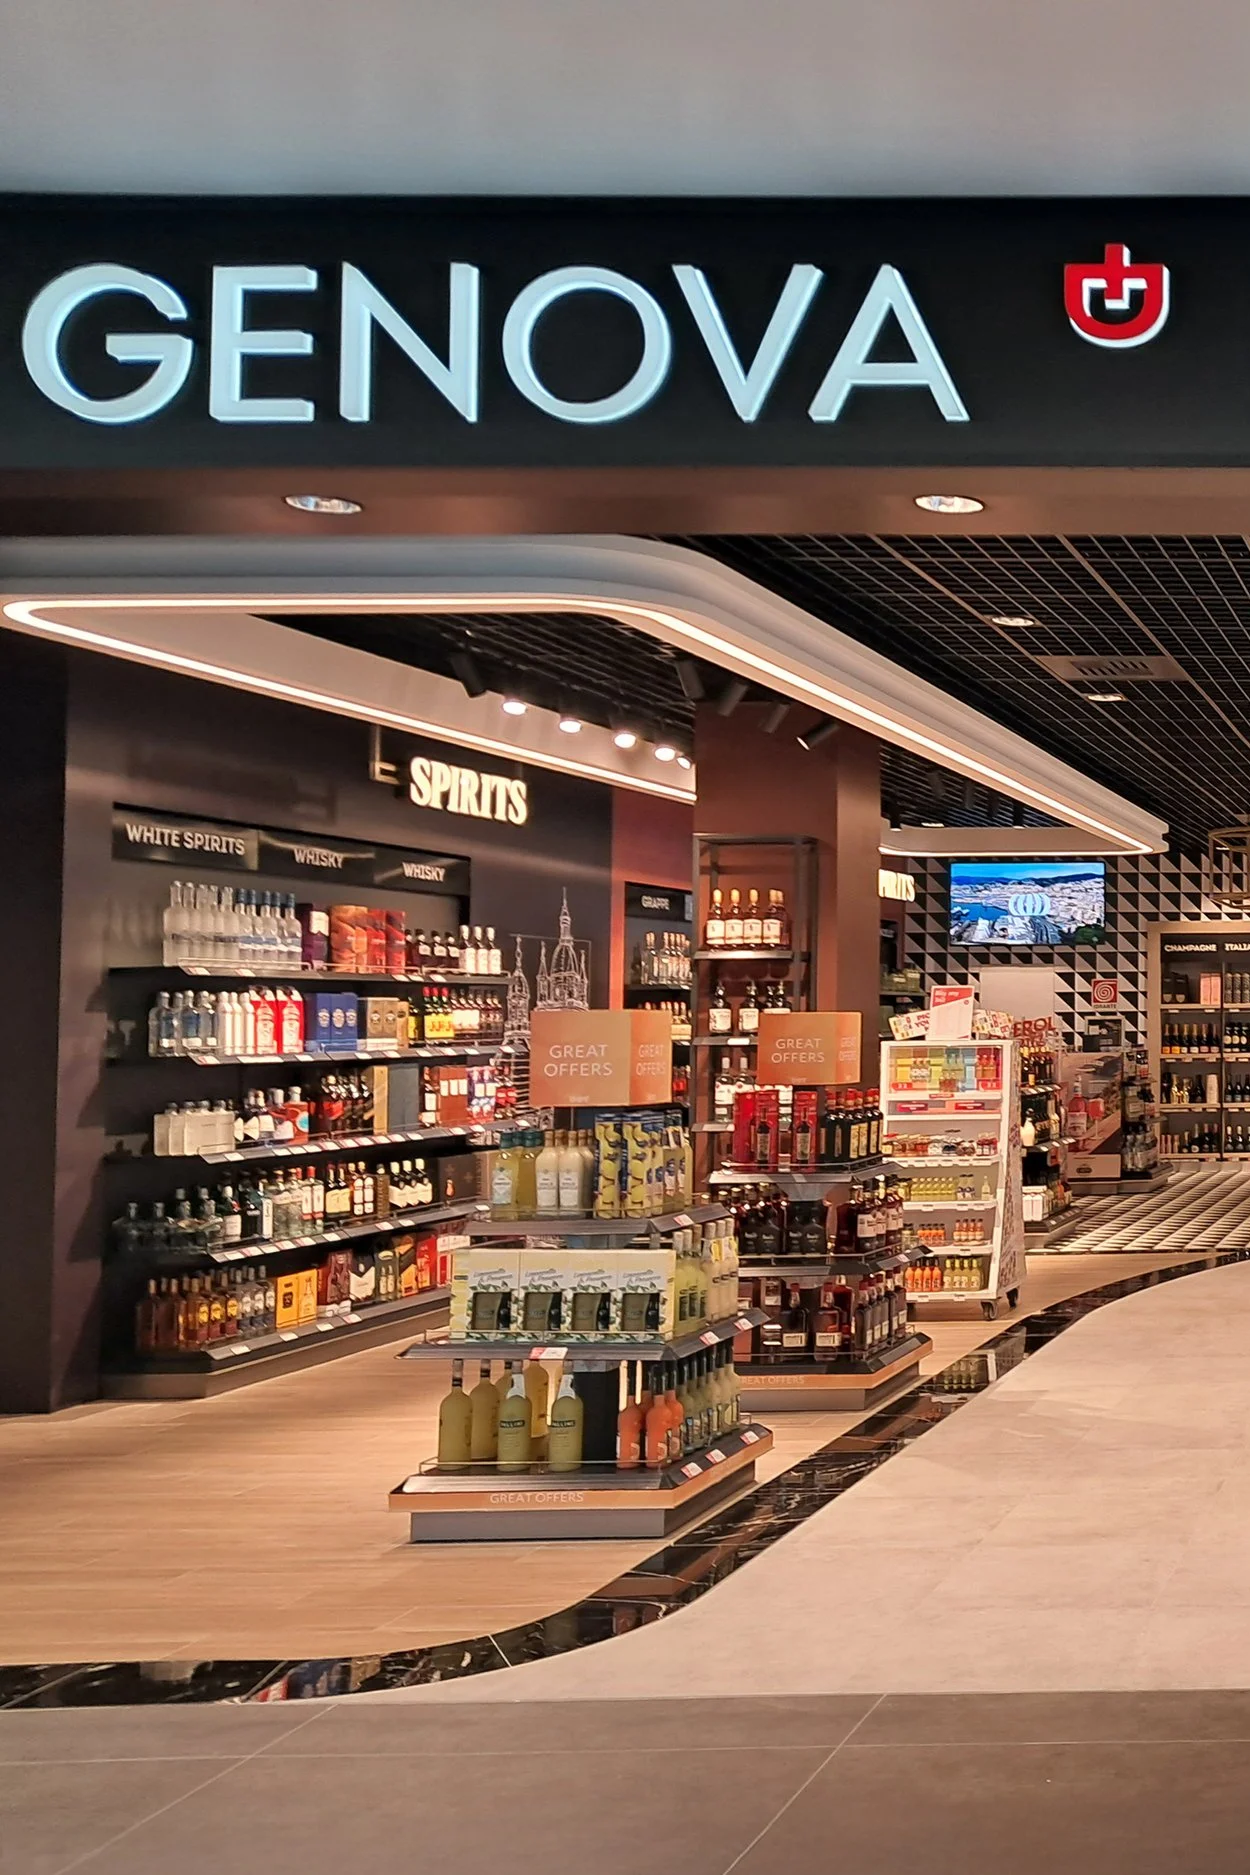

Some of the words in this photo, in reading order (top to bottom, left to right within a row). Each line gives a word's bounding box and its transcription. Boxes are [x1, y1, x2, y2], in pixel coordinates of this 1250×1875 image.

[22, 262, 970, 425] GENOVA
[410, 757, 527, 825] SPIRITS
[126, 823, 181, 848] WHITE
[184, 832, 246, 856] SPIRITS
[293, 848, 344, 869] WHISKY
[402, 862, 446, 882] WHISKY
[1164, 943, 1217, 952] CHAMPAGNE
[638, 1044, 665, 1058] GREAT
[776, 1038, 822, 1050] GREAT
[549, 1044, 608, 1059] GREAT
[771, 1052, 825, 1063] OFFERS
[543, 1063, 613, 1077] OFFERS
[636, 1062, 667, 1076] OFFERS
[738, 1377, 767, 1386] REAT
[768, 1376, 805, 1386] OFFERS
[490, 1493, 531, 1504] GREAT
[535, 1491, 584, 1503] OFFERS
